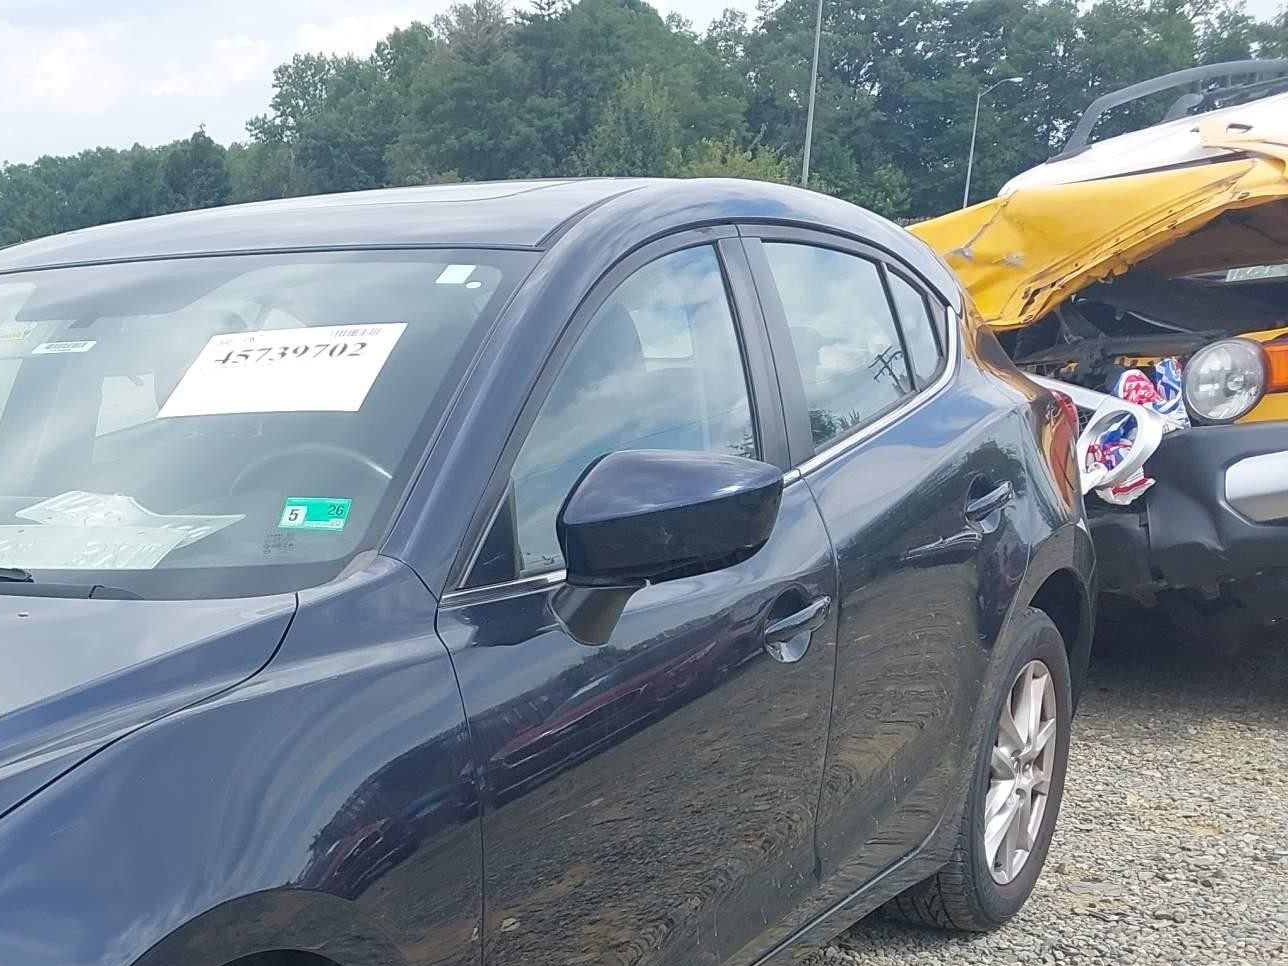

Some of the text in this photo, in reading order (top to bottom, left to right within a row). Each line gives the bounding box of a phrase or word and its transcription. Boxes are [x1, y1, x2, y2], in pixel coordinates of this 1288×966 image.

[215, 341, 369, 366] 45739702
[288, 508, 300, 521] 5
[328, 504, 344, 516] 26
